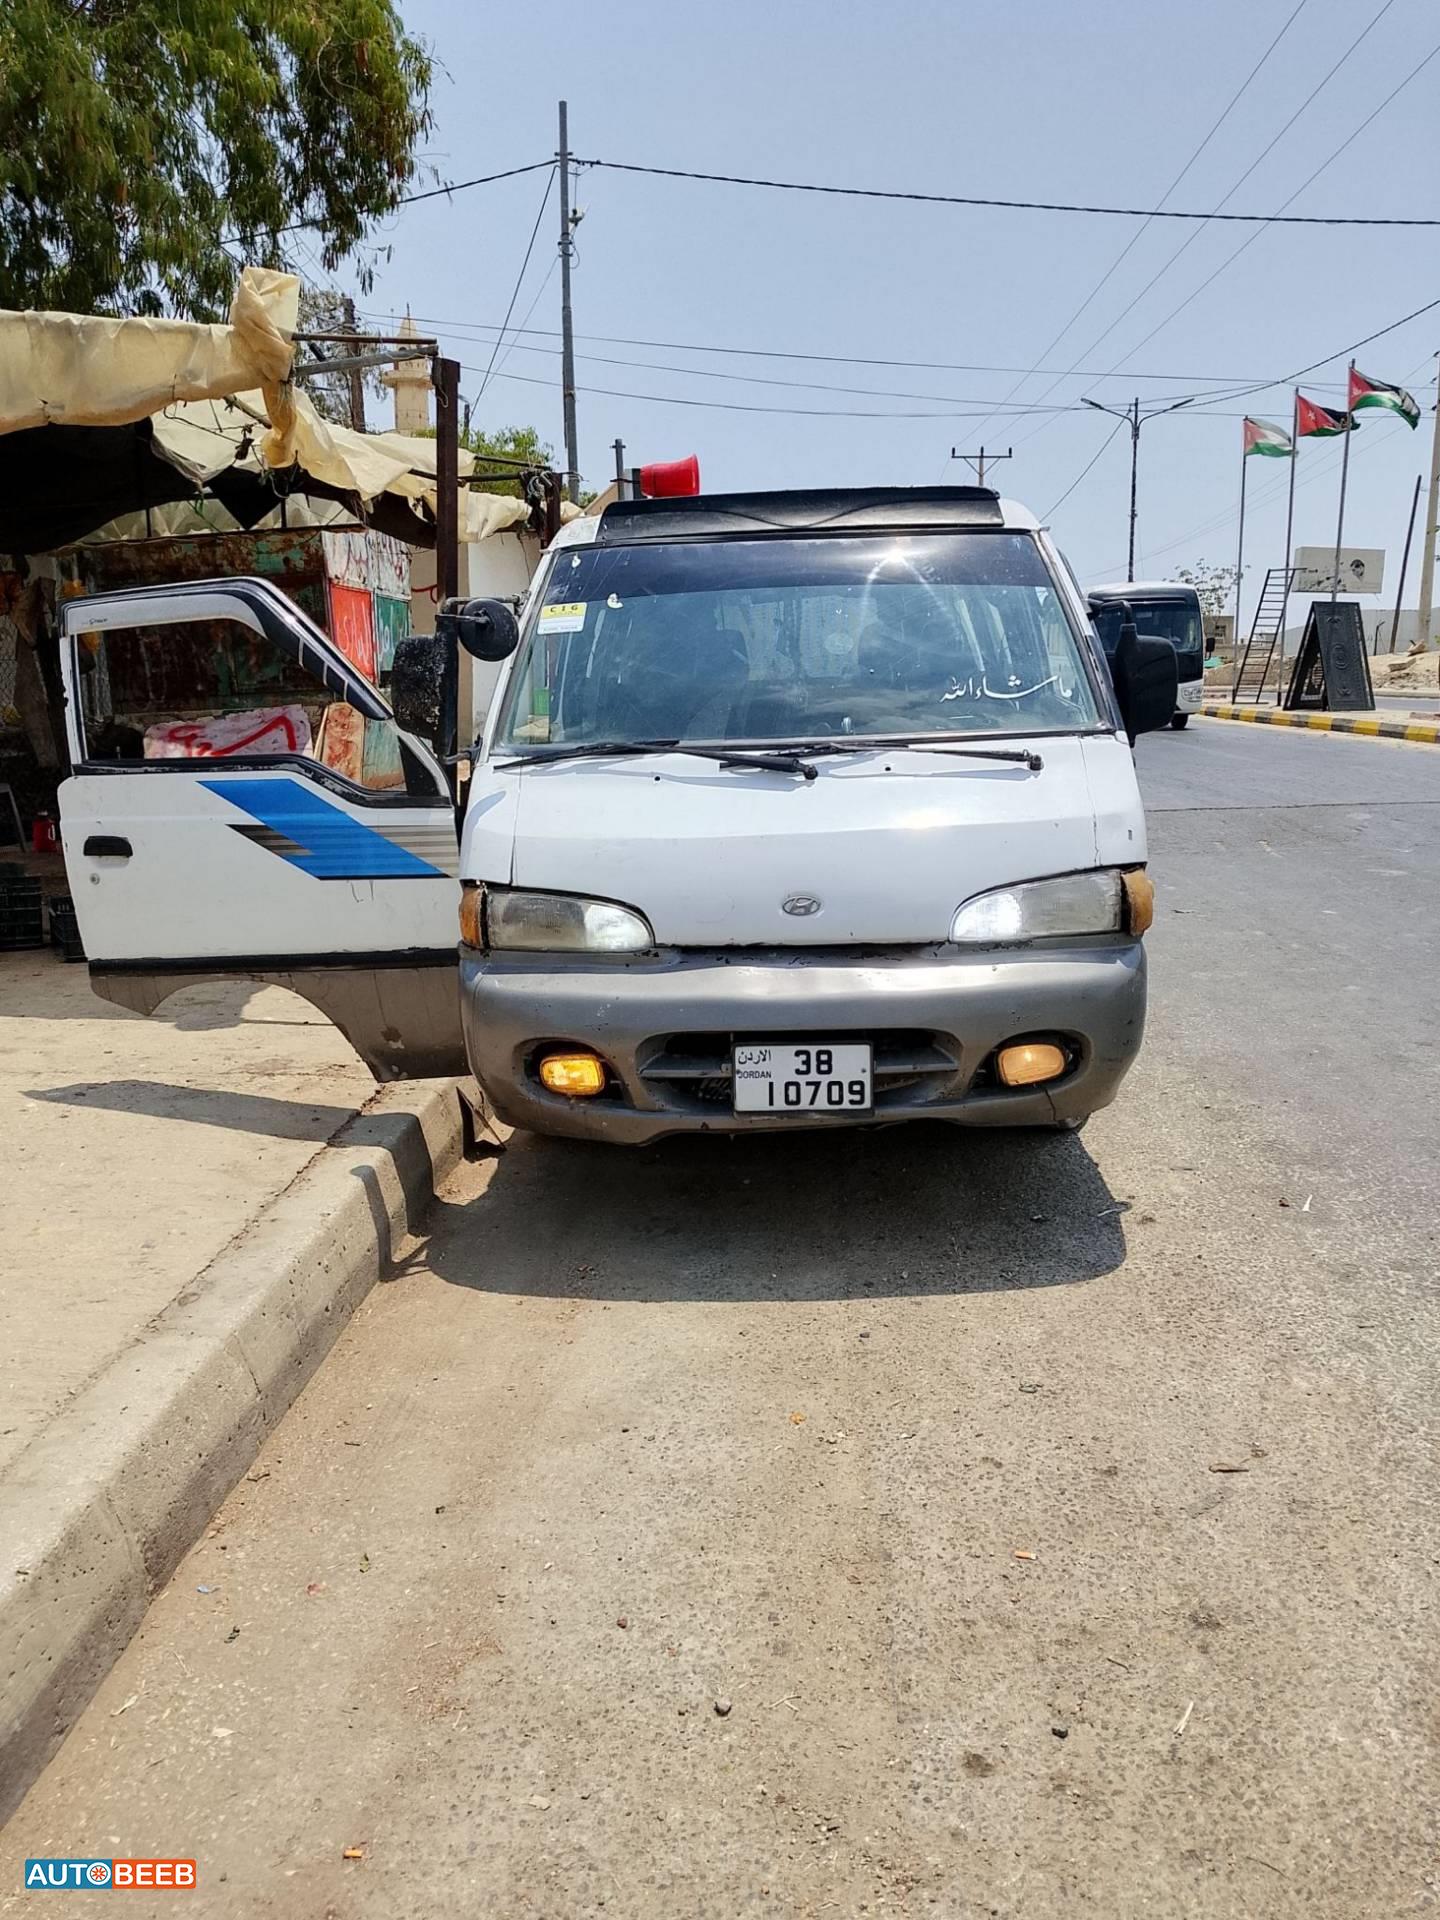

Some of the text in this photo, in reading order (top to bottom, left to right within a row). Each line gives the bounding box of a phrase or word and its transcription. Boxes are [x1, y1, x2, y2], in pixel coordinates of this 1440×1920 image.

[737, 1070, 772, 1080] JORDAN
[794, 1049, 833, 1075] 38
[768, 1080, 865, 1106] 10709
